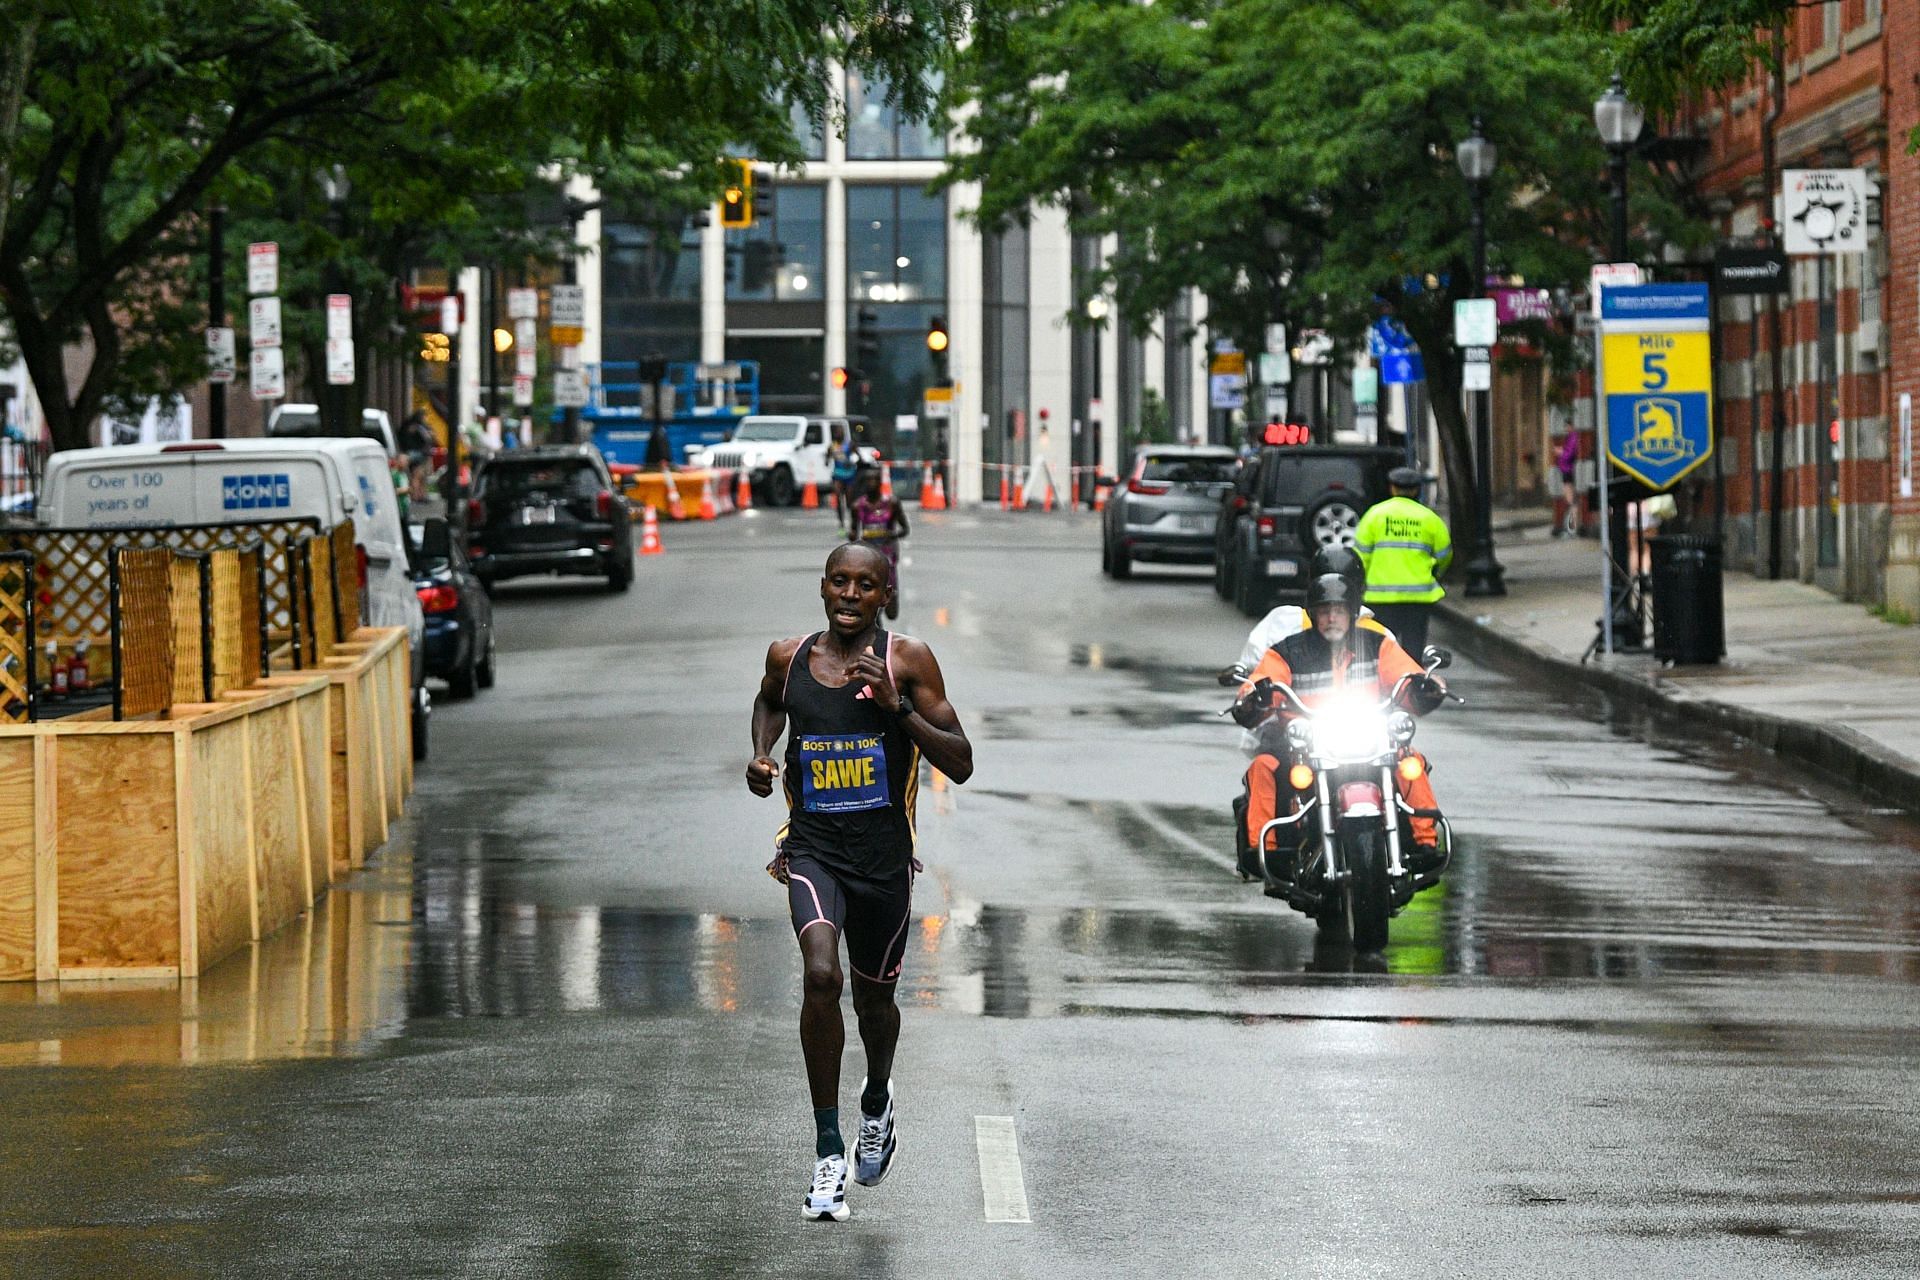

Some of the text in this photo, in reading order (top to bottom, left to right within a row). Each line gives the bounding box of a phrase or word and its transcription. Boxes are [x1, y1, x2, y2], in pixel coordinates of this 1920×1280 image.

[1639, 335, 1675, 348] Mile
[1642, 353, 1668, 390] 5
[88, 472, 163, 489] Over 100
[223, 482, 289, 500] KONE
[88, 494, 149, 515] years of
[1385, 525, 1421, 537] Police
[857, 738, 879, 750] 10K
[810, 756, 876, 790] SAWE
